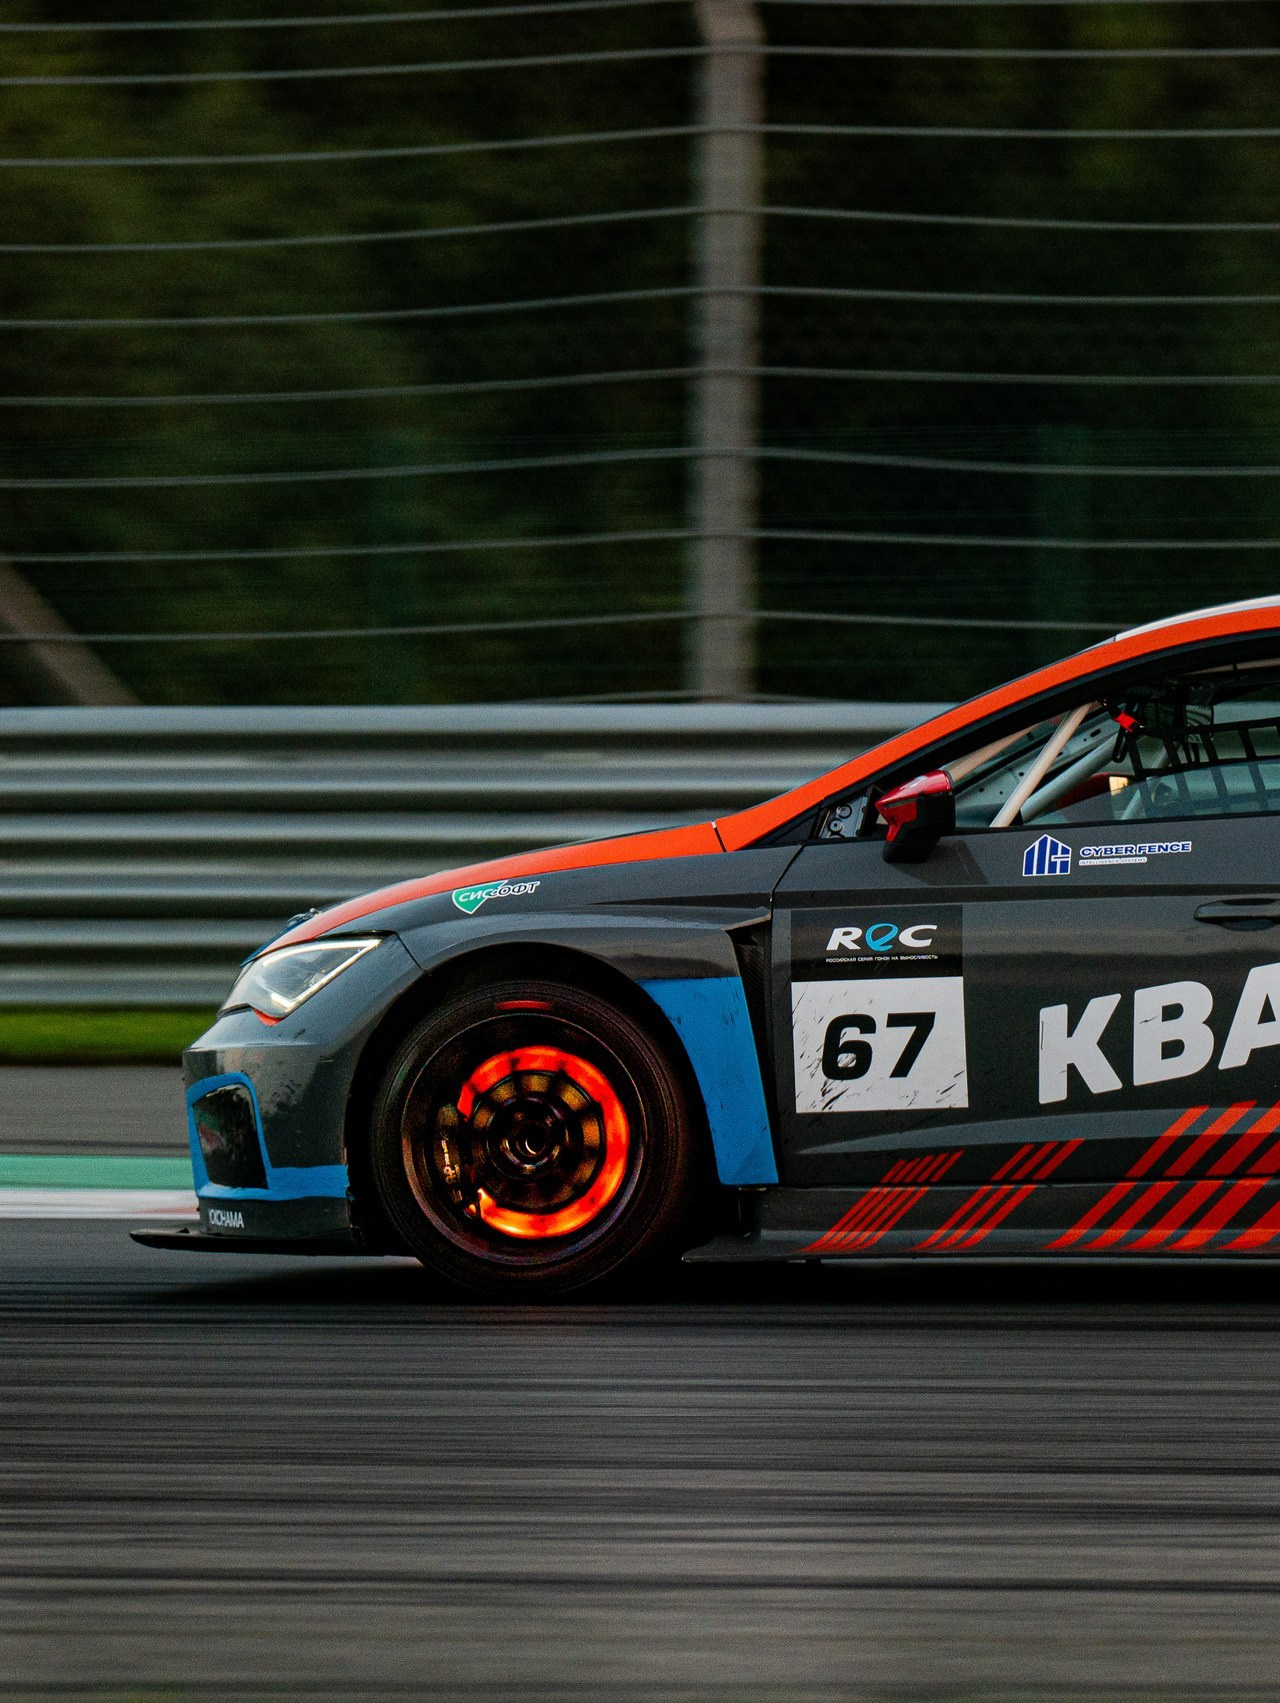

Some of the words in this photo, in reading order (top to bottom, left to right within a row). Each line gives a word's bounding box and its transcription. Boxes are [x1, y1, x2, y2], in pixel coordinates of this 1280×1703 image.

[1081, 846, 1135, 857] CYBER
[1137, 842, 1191, 854] FENCE
[822, 1012, 936, 1080] 67
